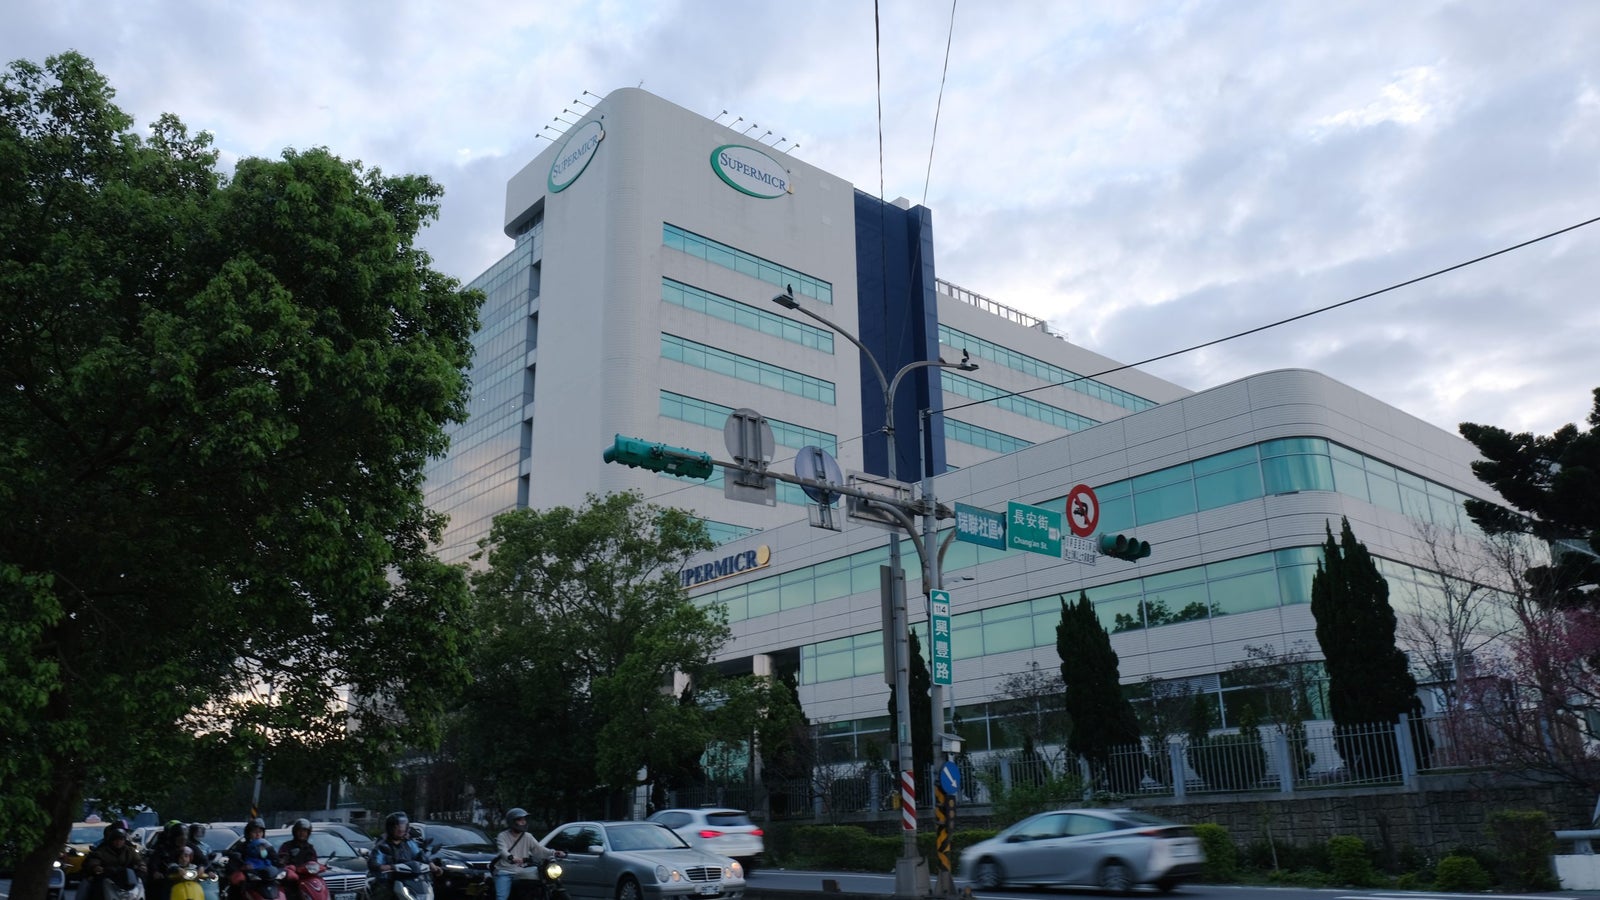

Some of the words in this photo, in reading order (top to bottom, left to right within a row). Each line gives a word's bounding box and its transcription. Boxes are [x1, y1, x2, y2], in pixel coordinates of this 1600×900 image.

[957, 511, 999, 540] 瑞聯社區
[1013, 509, 1049, 531] 長安街
[1013, 536, 1040, 548] Chang'an
[935, 605, 946, 613] 114
[935, 619, 949, 680] 興豐路
